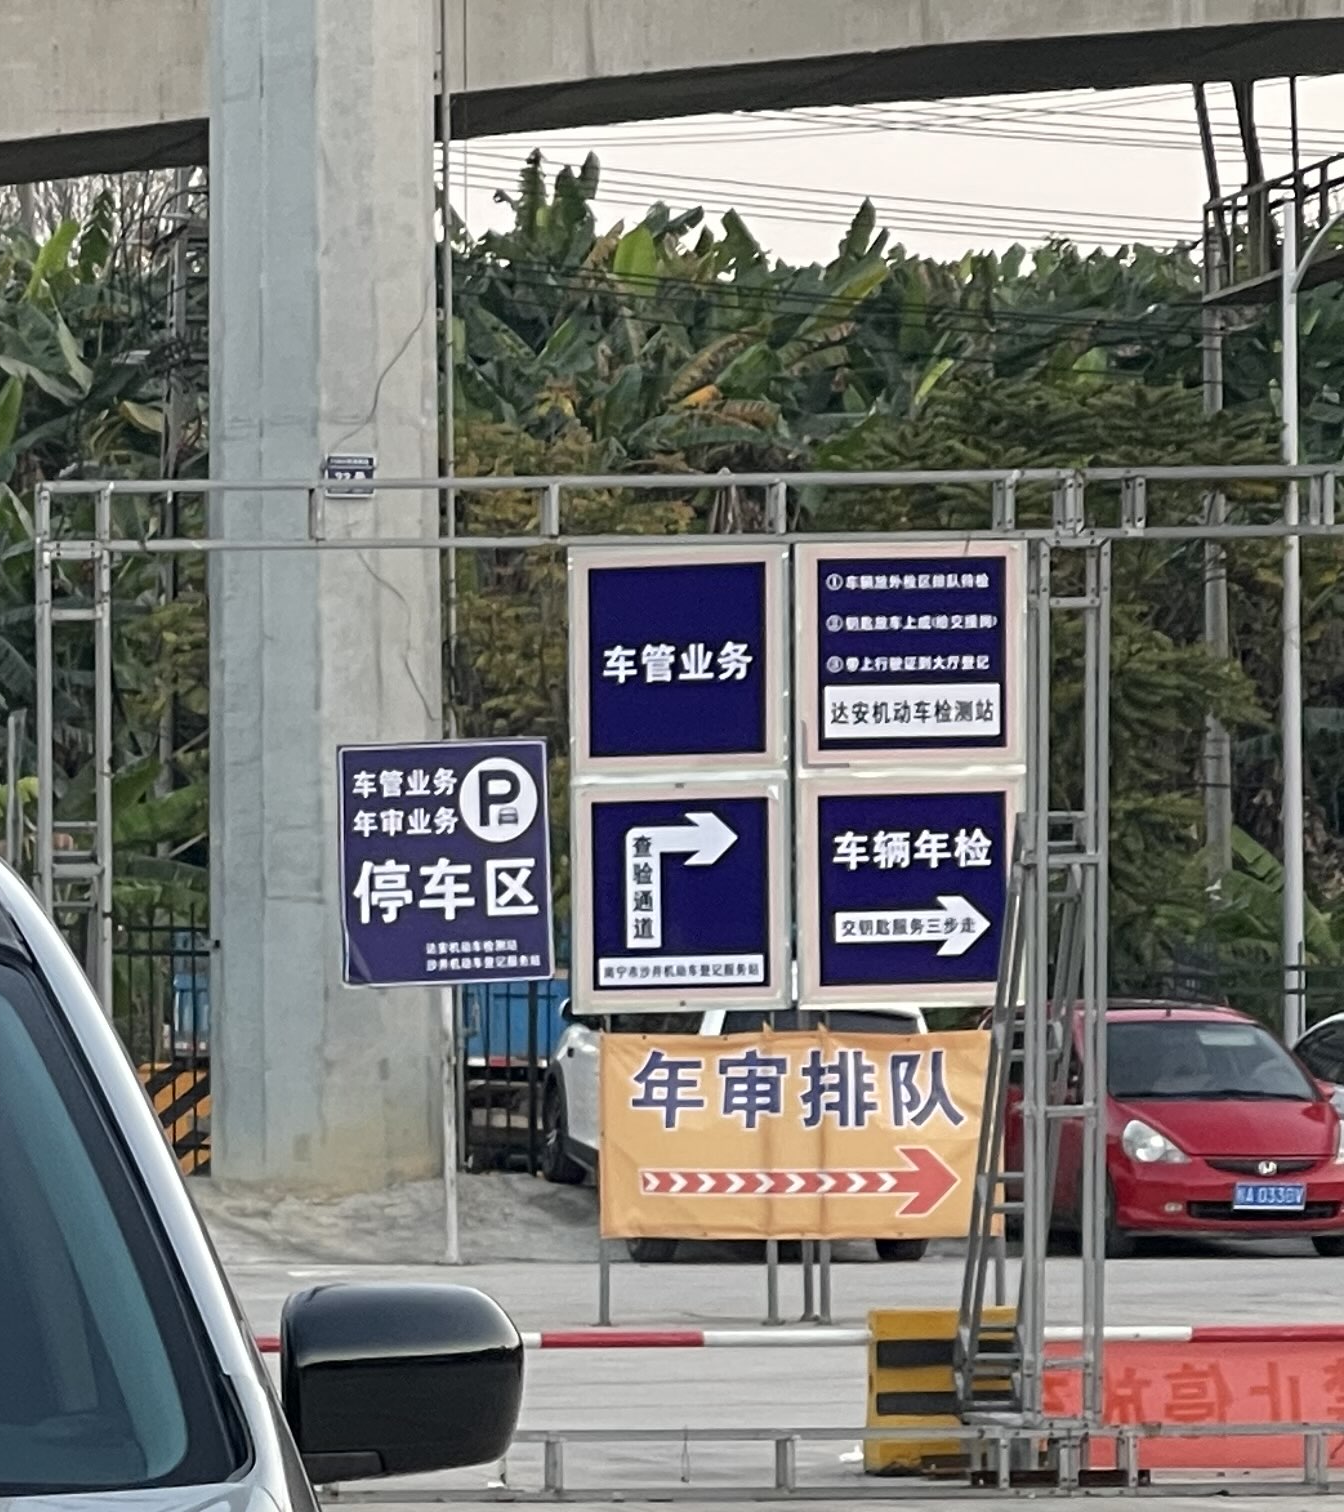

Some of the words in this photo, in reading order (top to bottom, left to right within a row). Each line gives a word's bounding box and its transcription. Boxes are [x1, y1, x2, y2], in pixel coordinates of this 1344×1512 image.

[603, 641, 753, 684] 车管业务
[830, 699, 994, 725] 达安机动车检测站
[352, 768, 458, 799] 车管业务
[353, 807, 459, 838] 年审业务
[832, 828, 993, 871] 车辆年检
[352, 857, 540, 924] 停车区
[632, 835, 654, 939] 查验通道
[841, 917, 977, 937] 交钥匙服务三步走
[631, 1049, 965, 1129] 年审排队
